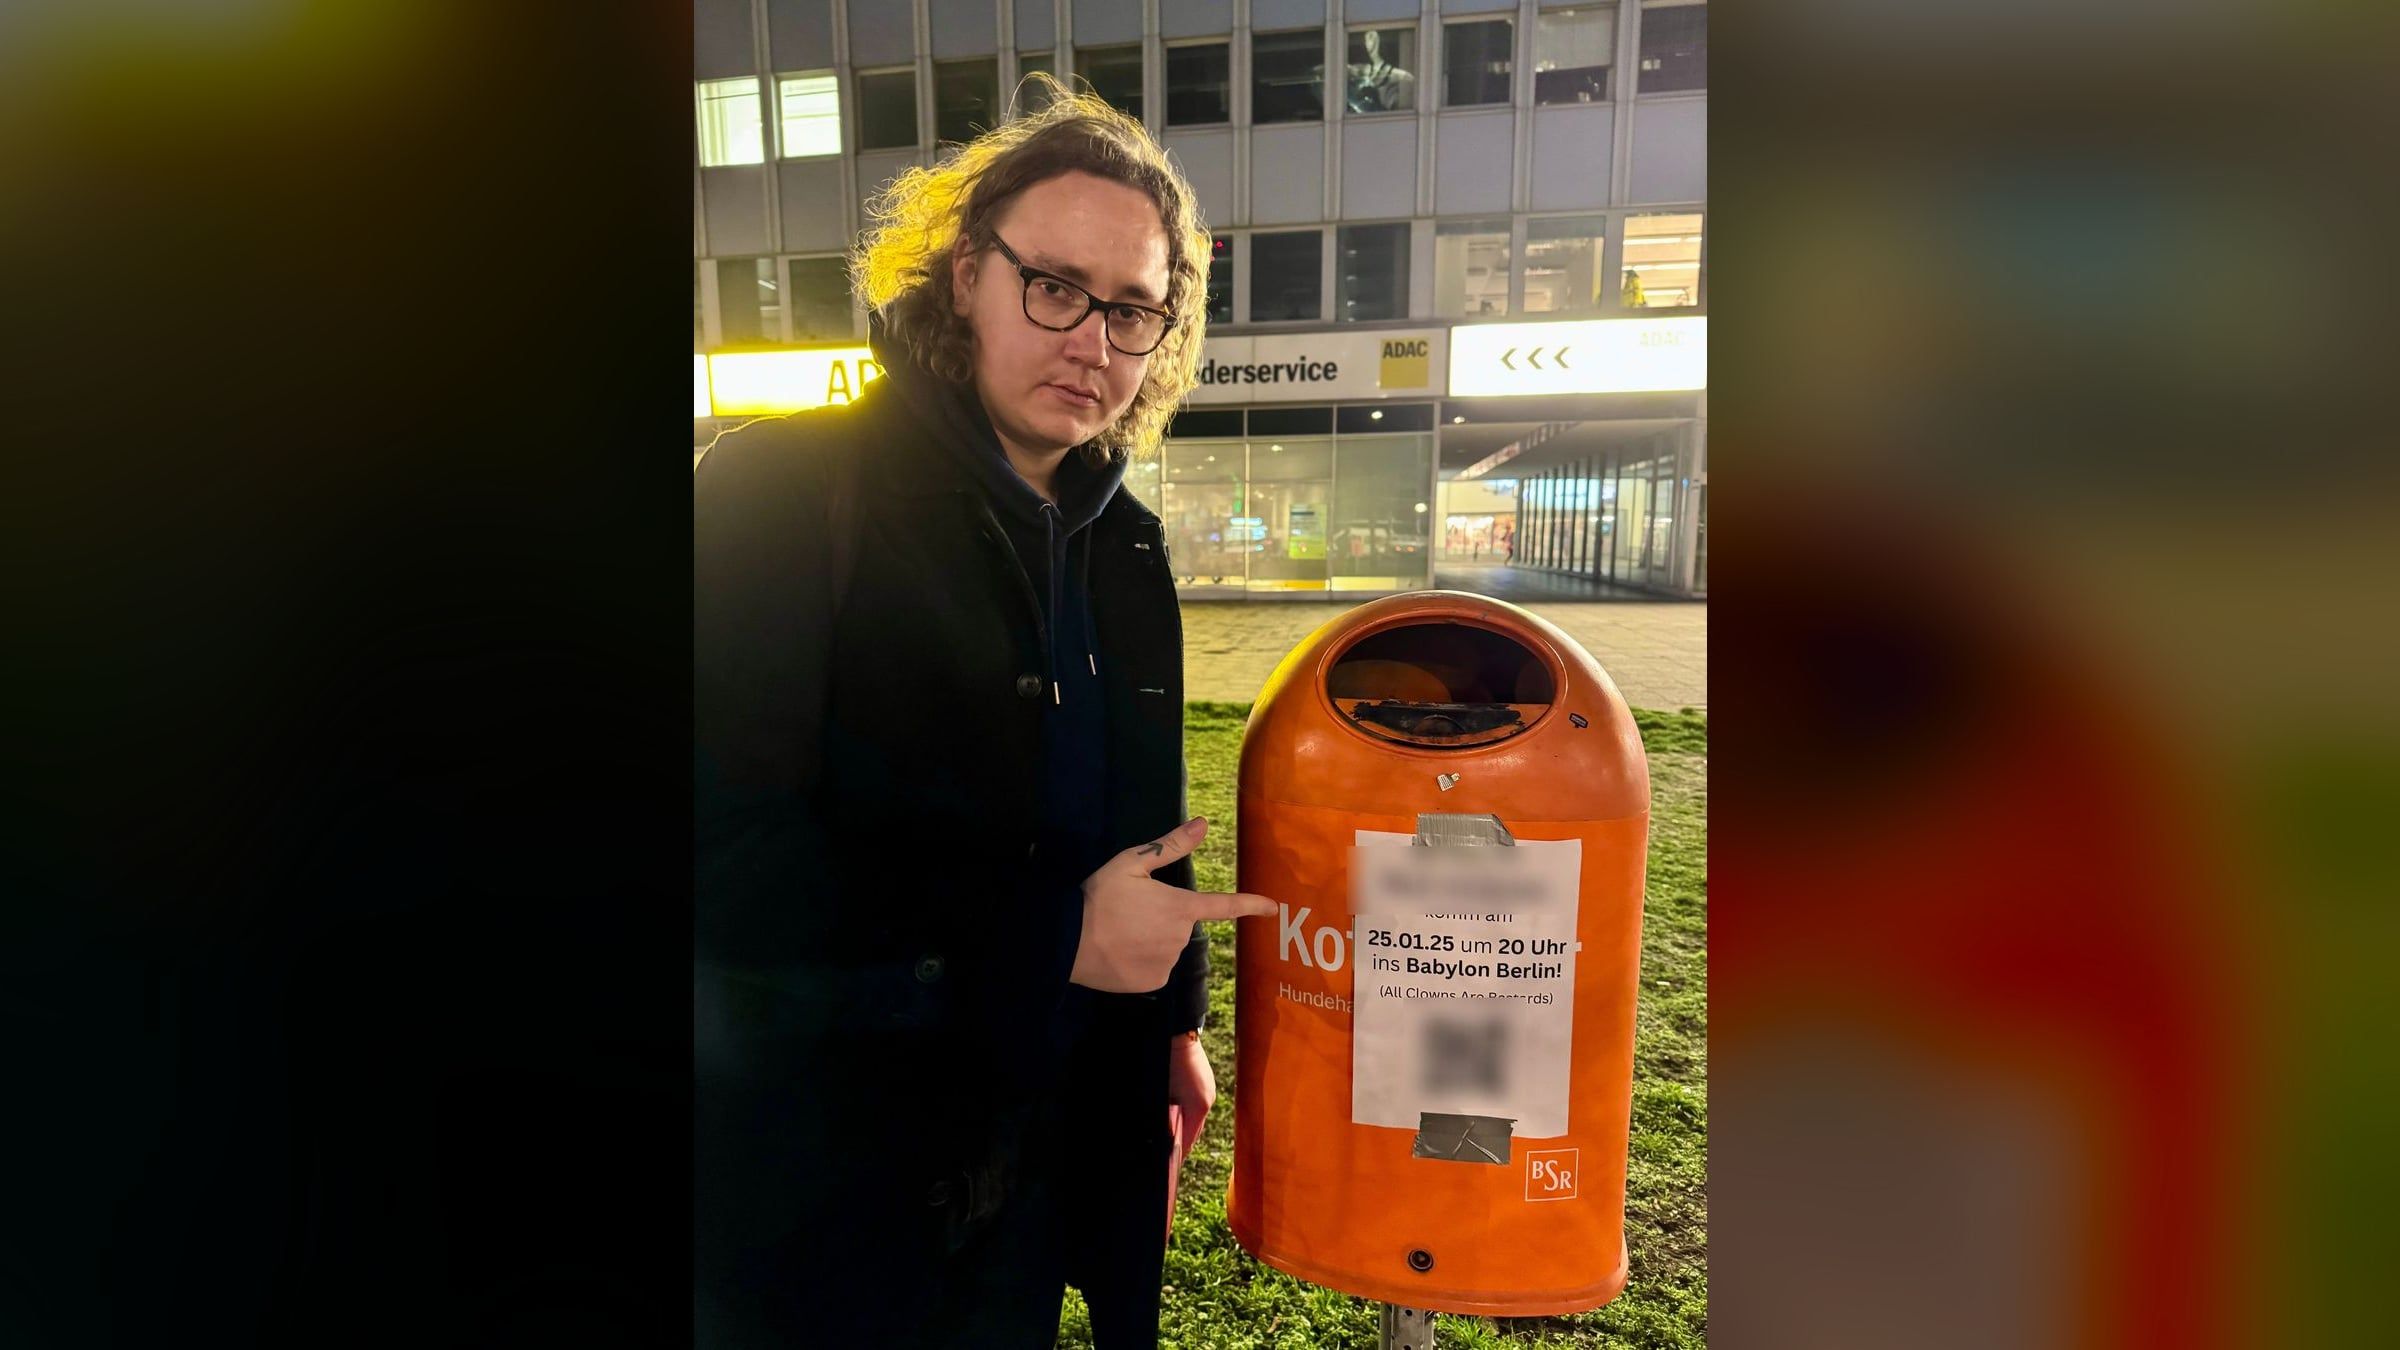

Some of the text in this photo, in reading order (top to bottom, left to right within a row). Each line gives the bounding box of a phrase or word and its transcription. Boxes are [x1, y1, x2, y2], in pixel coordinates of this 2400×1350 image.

[1383, 340, 1428, 359] ADAC
[1195, 356, 1338, 385] derservice
[1279, 902, 1354, 972] Ko
[1368, 929, 1567, 955] 25.01.25 um 20 Uhr
[1372, 953, 1562, 979] ins Babylon Berlin!
[1380, 985, 1402, 999] (All
[1406, 987, 1457, 999] Clowns
[1532, 1159, 1573, 1191] BSR
